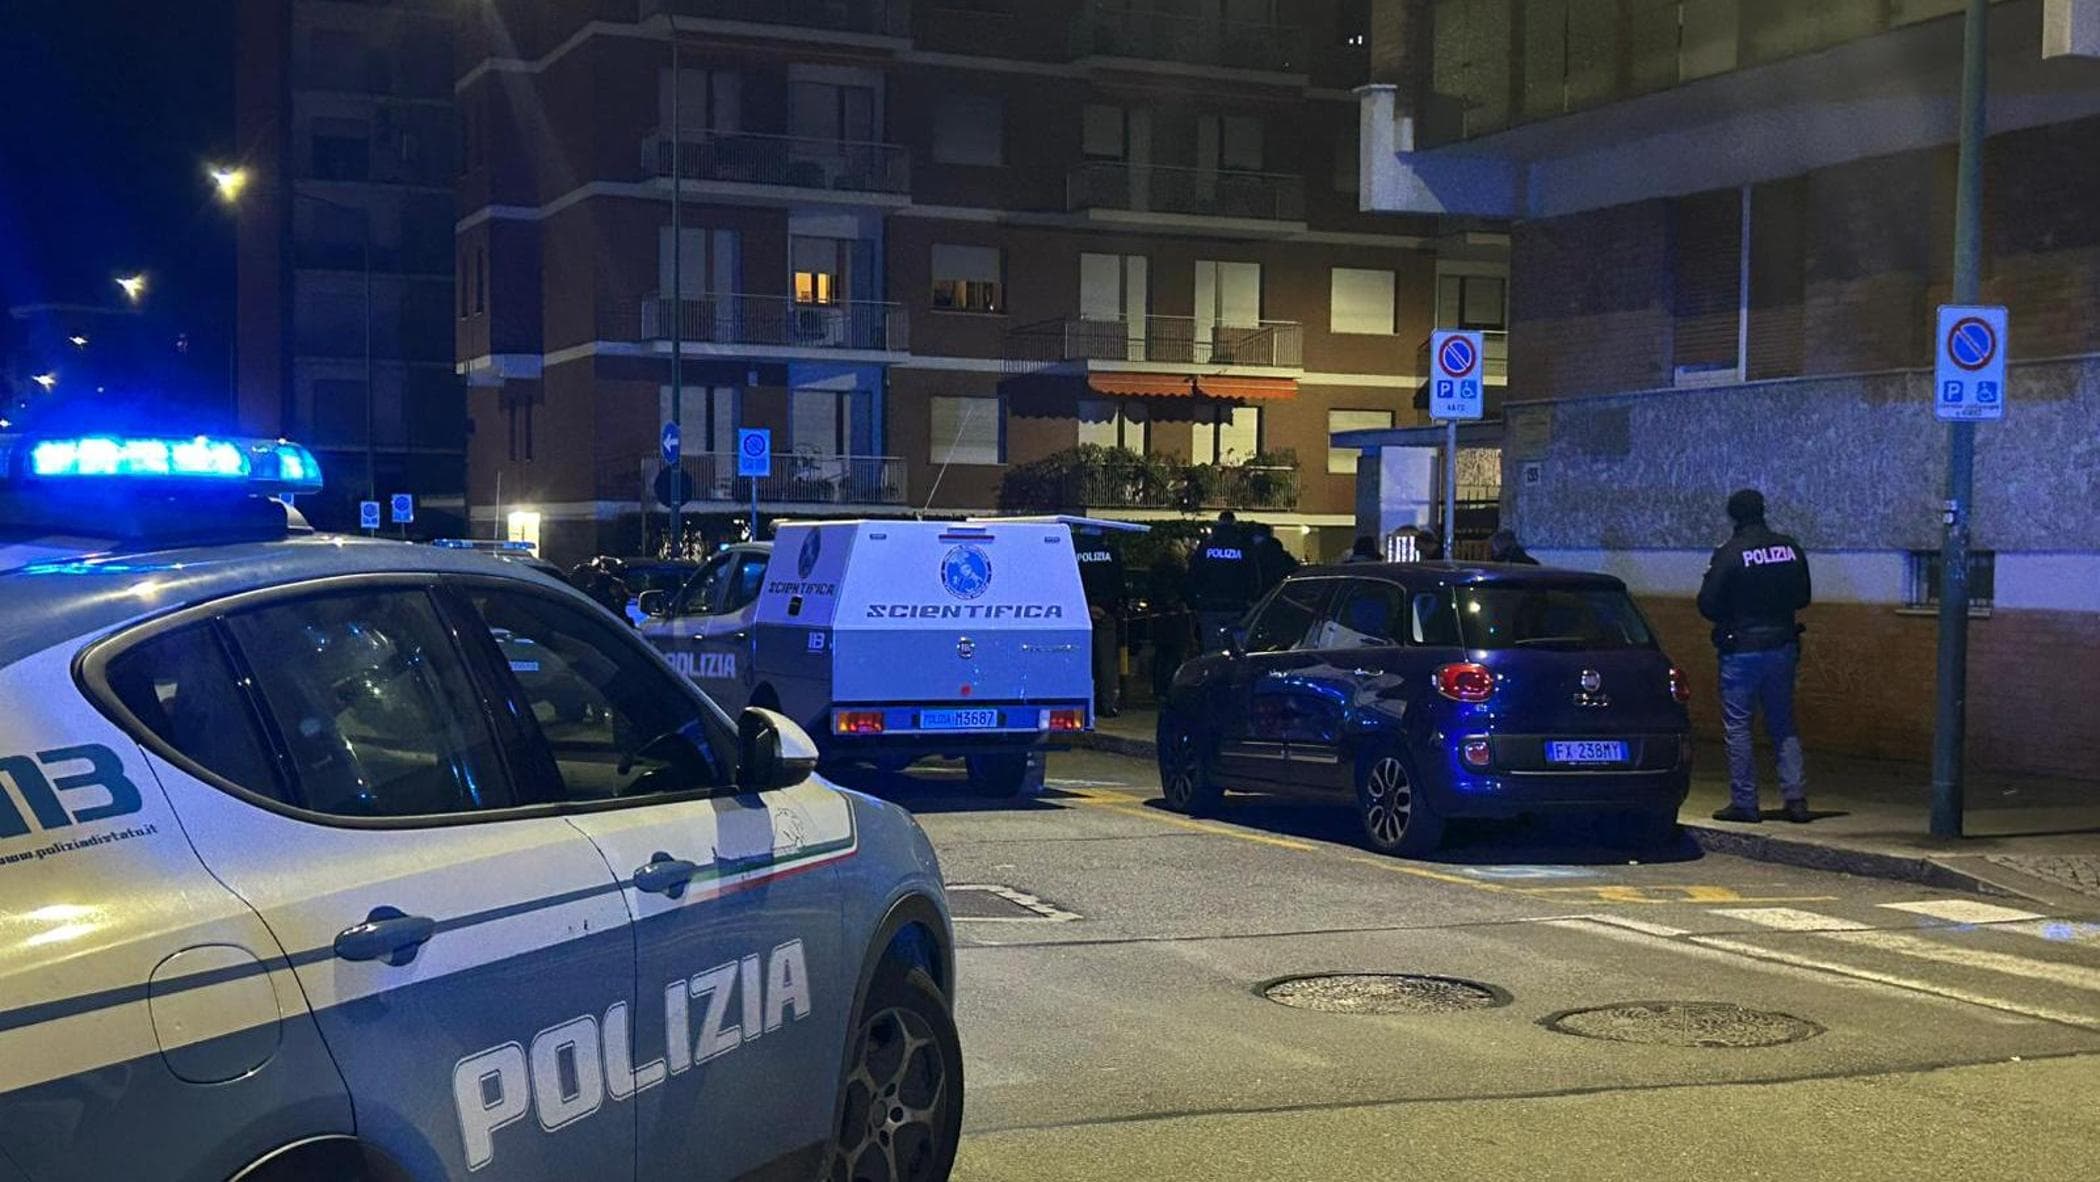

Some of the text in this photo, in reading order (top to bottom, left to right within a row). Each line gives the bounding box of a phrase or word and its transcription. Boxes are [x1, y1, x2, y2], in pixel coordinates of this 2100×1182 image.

[1077, 551, 1112, 563] POLIZIA
[1206, 547, 1242, 560] POLIZIA
[1742, 545, 1797, 567] POLIZIA
[867, 604, 1063, 619] SCIENTIFICA
[955, 711, 995, 726] M3687
[1555, 743, 1620, 759] FX 238MY
[453, 937, 811, 1172] POLIZIA
